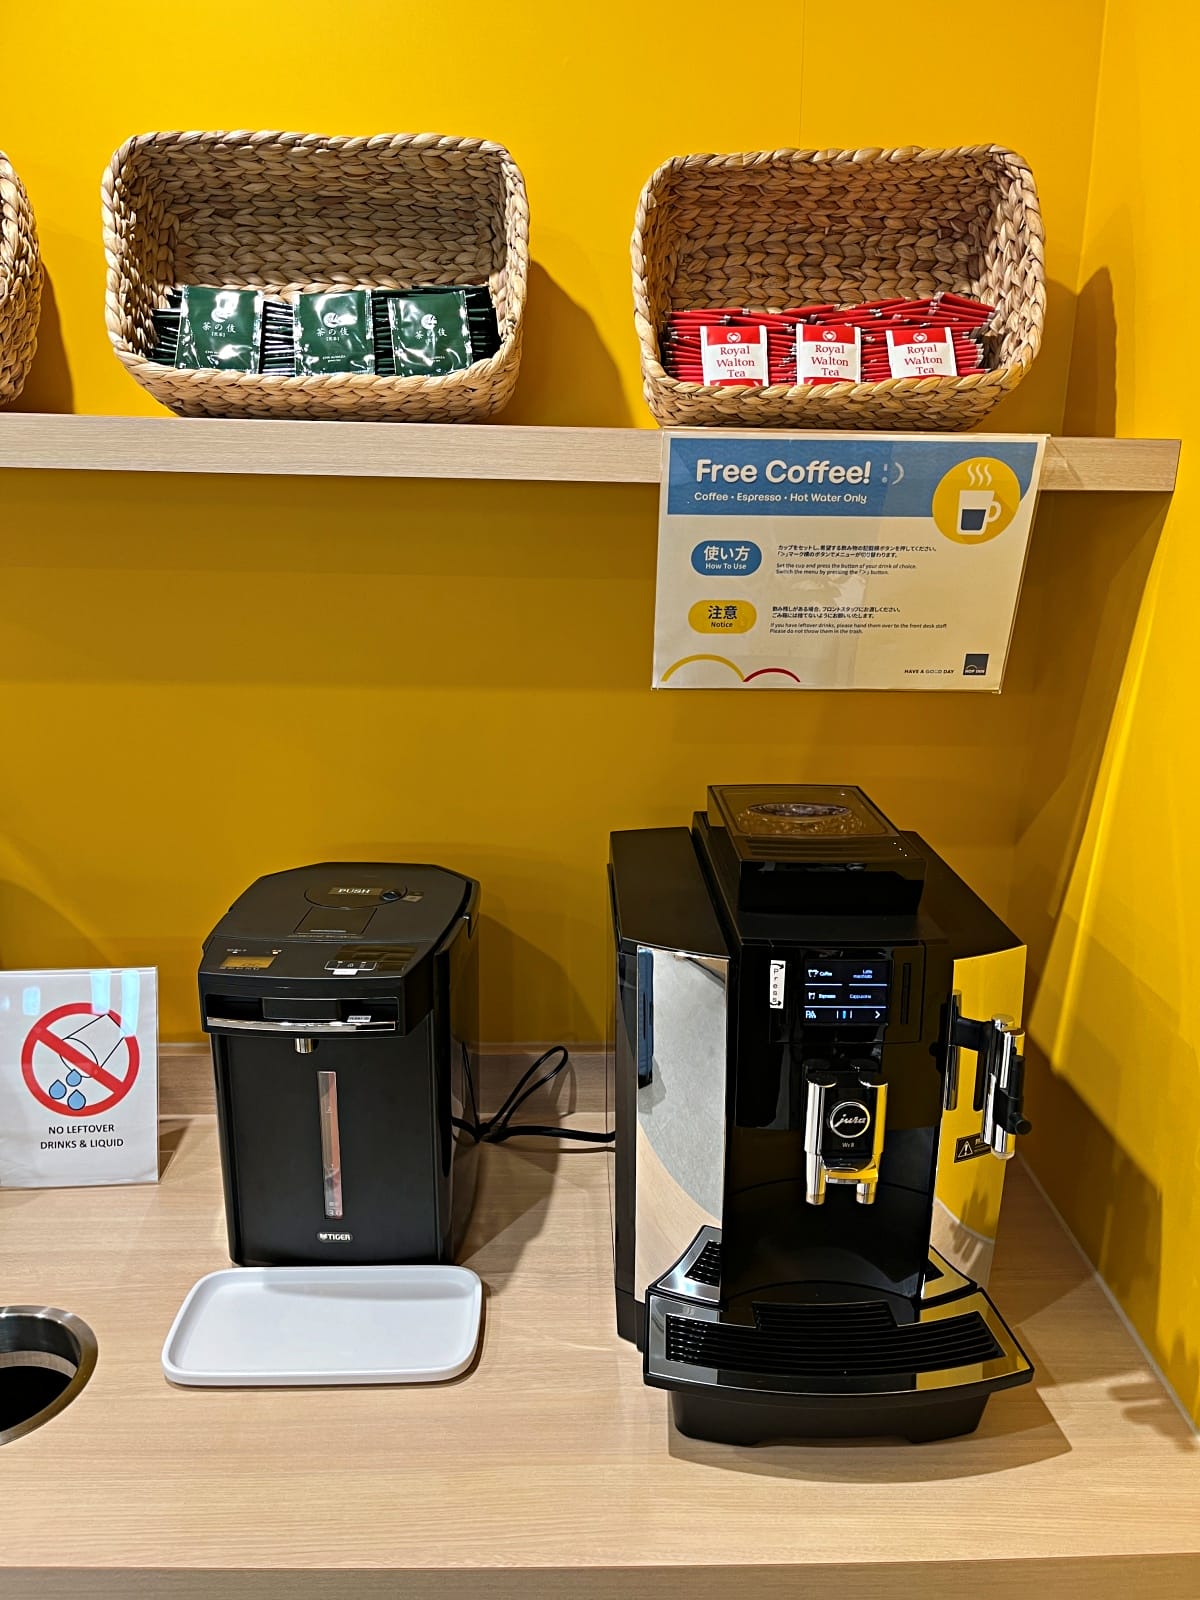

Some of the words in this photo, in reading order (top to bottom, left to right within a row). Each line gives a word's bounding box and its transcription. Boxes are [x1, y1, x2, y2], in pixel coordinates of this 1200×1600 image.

[719, 344, 750, 357] Royal
[815, 343, 845, 355] Royal
[907, 343, 937, 356] Royal
[716, 356, 755, 367] Walton
[810, 355, 849, 367] Walton
[903, 354, 943, 365] Walton
[727, 368, 746, 378] Tea
[821, 367, 840, 377] Tea
[915, 365, 935, 375] Tea
[696, 458, 758, 483] Free
[765, 459, 872, 485] Coffee!
[694, 491, 729, 501] Coffee
[736, 492, 782, 503] Espresso
[790, 493, 808, 502] Hot
[810, 493, 841, 503] Water
[843, 493, 867, 505] Only
[703, 545, 751, 562] 使い方
[705, 562, 722, 570] How
[723, 562, 732, 570] To
[733, 562, 747, 570] Use
[708, 605, 738, 620] 注意
[832, 1113, 867, 1128] jura
[48, 1125, 64, 1134] NO
[66, 1124, 115, 1134] LEFTOVER
[40, 1140, 77, 1150] DRINKS
[79, 1140, 87, 1148] &
[90, 1138, 124, 1148] LIQUID
[328, 1233, 351, 1241] TIGER
